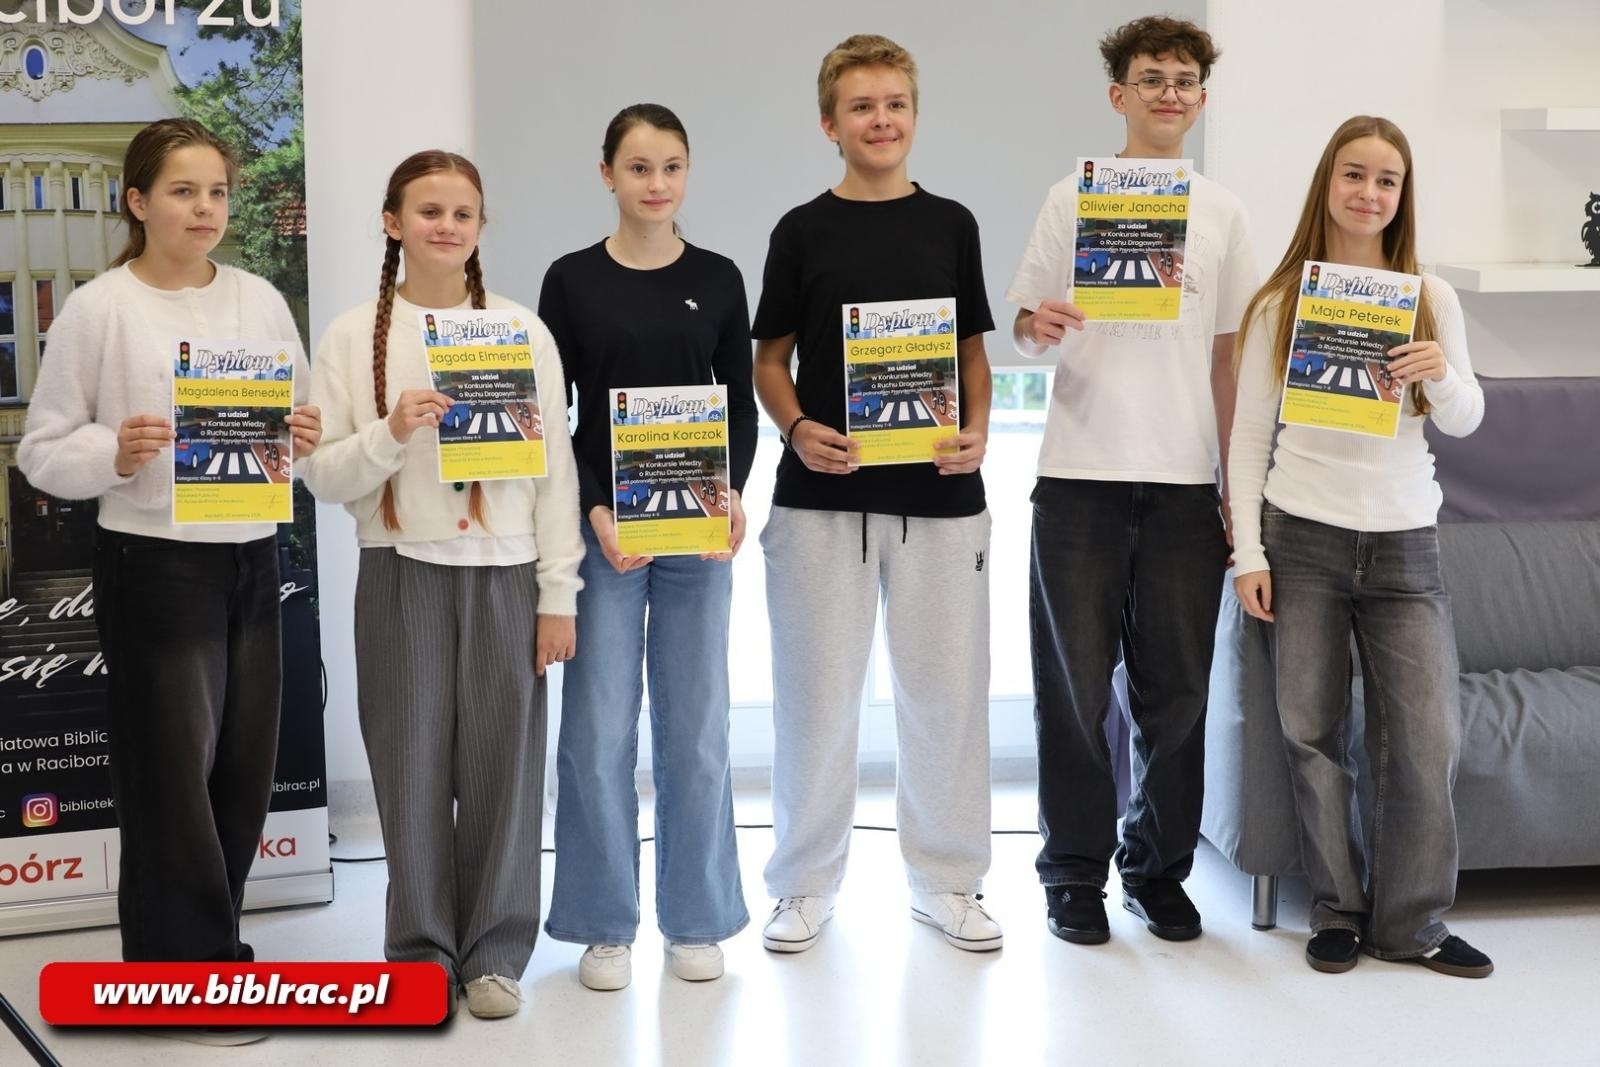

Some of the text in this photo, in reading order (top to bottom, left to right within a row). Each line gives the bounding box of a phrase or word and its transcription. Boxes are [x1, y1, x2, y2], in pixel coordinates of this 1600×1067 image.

[1097, 167, 1171, 189] Dyplom
[1080, 201, 1185, 213] Oliwier Janocha
[1140, 231, 1162, 239] Wiedzy
[1321, 273, 1399, 299] Dyplom
[864, 308, 935, 333] Dyplom
[1311, 305, 1402, 326] Maja Peterek
[441, 318, 510, 341] Dyplom
[1347, 330, 1369, 338] udział
[850, 342, 951, 357] Grzegorz Gładysz
[1326, 336, 1359, 346] Konkursie
[1360, 340, 1384, 350] Wiedzy
[1323, 344, 1345, 352] Ruchu
[1346, 346, 1383, 357] Drogowym
[194, 349, 273, 373] Dyplom
[430, 351, 531, 366] Jagoda Elmerych
[494, 382, 515, 390] Wiedzy
[899, 380, 933, 388] Drogowym
[177, 387, 290, 400] Magdalena Benedykt
[484, 390, 516, 399] Drogowym
[631, 395, 705, 419] Dyplom
[242, 420, 266, 429] Wiedzy
[229, 429, 266, 438] Drogowym
[617, 429, 722, 443] Karolina Korczok
[678, 460, 702, 468] Wiedzy
[667, 468, 703, 476] Drogowym
[0, 642, 78, 689] się
[17, 761, 32, 773] w
